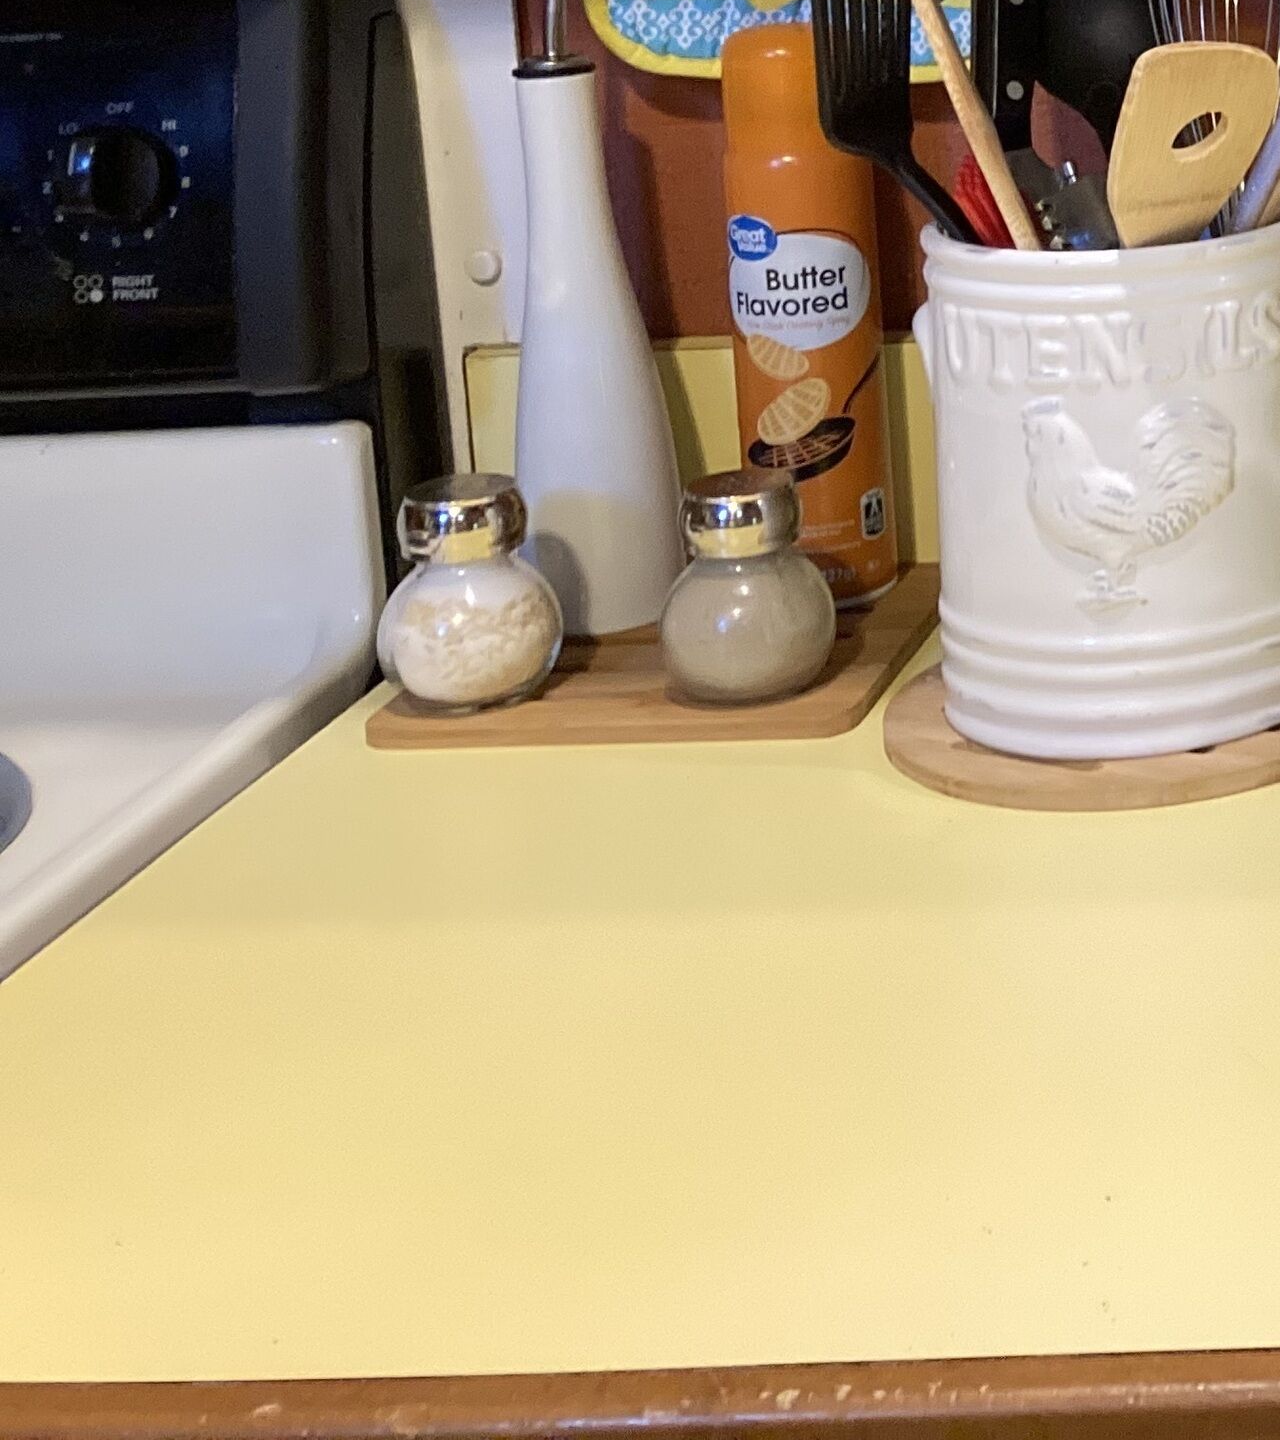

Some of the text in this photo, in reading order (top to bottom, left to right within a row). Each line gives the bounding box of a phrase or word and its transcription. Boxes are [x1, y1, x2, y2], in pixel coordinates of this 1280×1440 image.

[105, 101, 134, 114] OFF
[162, 119, 176, 132] HI
[730, 223, 766, 244] Great
[112, 274, 155, 287] RIGHT
[766, 266, 846, 291] Butter
[112, 287, 159, 301] FRONT
[737, 286, 849, 316] Flavored
